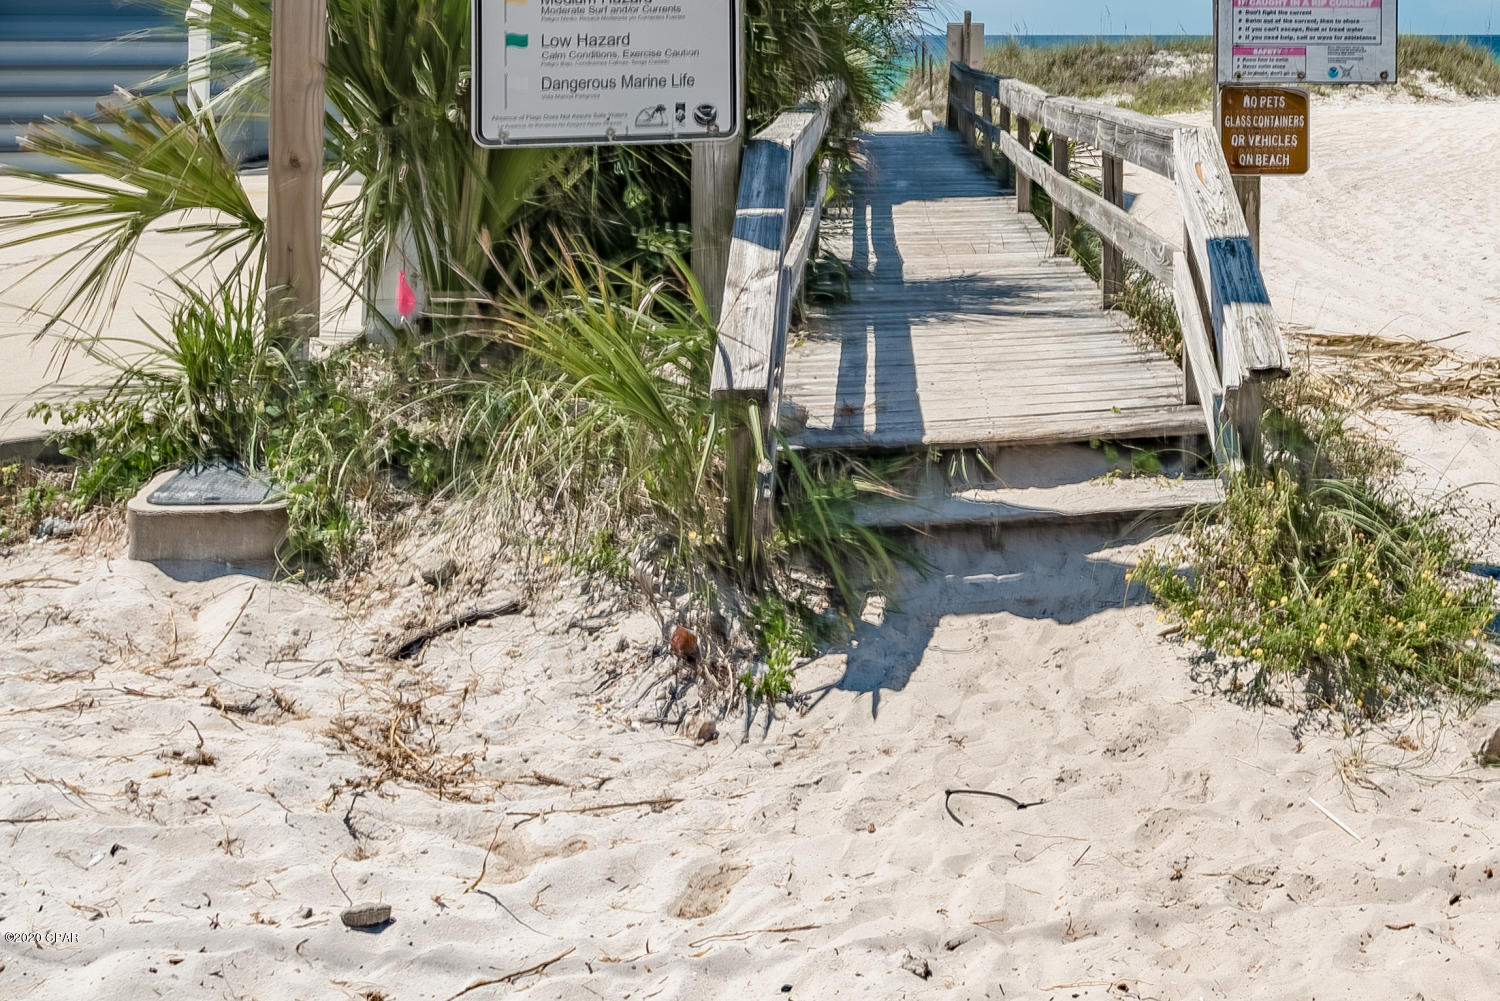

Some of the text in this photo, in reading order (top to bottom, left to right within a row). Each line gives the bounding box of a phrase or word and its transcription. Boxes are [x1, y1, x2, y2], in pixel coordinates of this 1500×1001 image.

[540, 4, 682, 15] Moderate Surf and/or Currents
[541, 32, 631, 48] Low Hazard
[541, 48, 700, 60] Calm Conditions, Exercise Caution
[541, 72, 695, 93] Dangerous Marine Life
[1243, 95, 1286, 108] NO PETS
[1224, 115, 1305, 128] GLASS CONTAINERS
[1231, 134, 1298, 147] OR VEHICLES
[1239, 154, 1290, 166] ON BEACH
